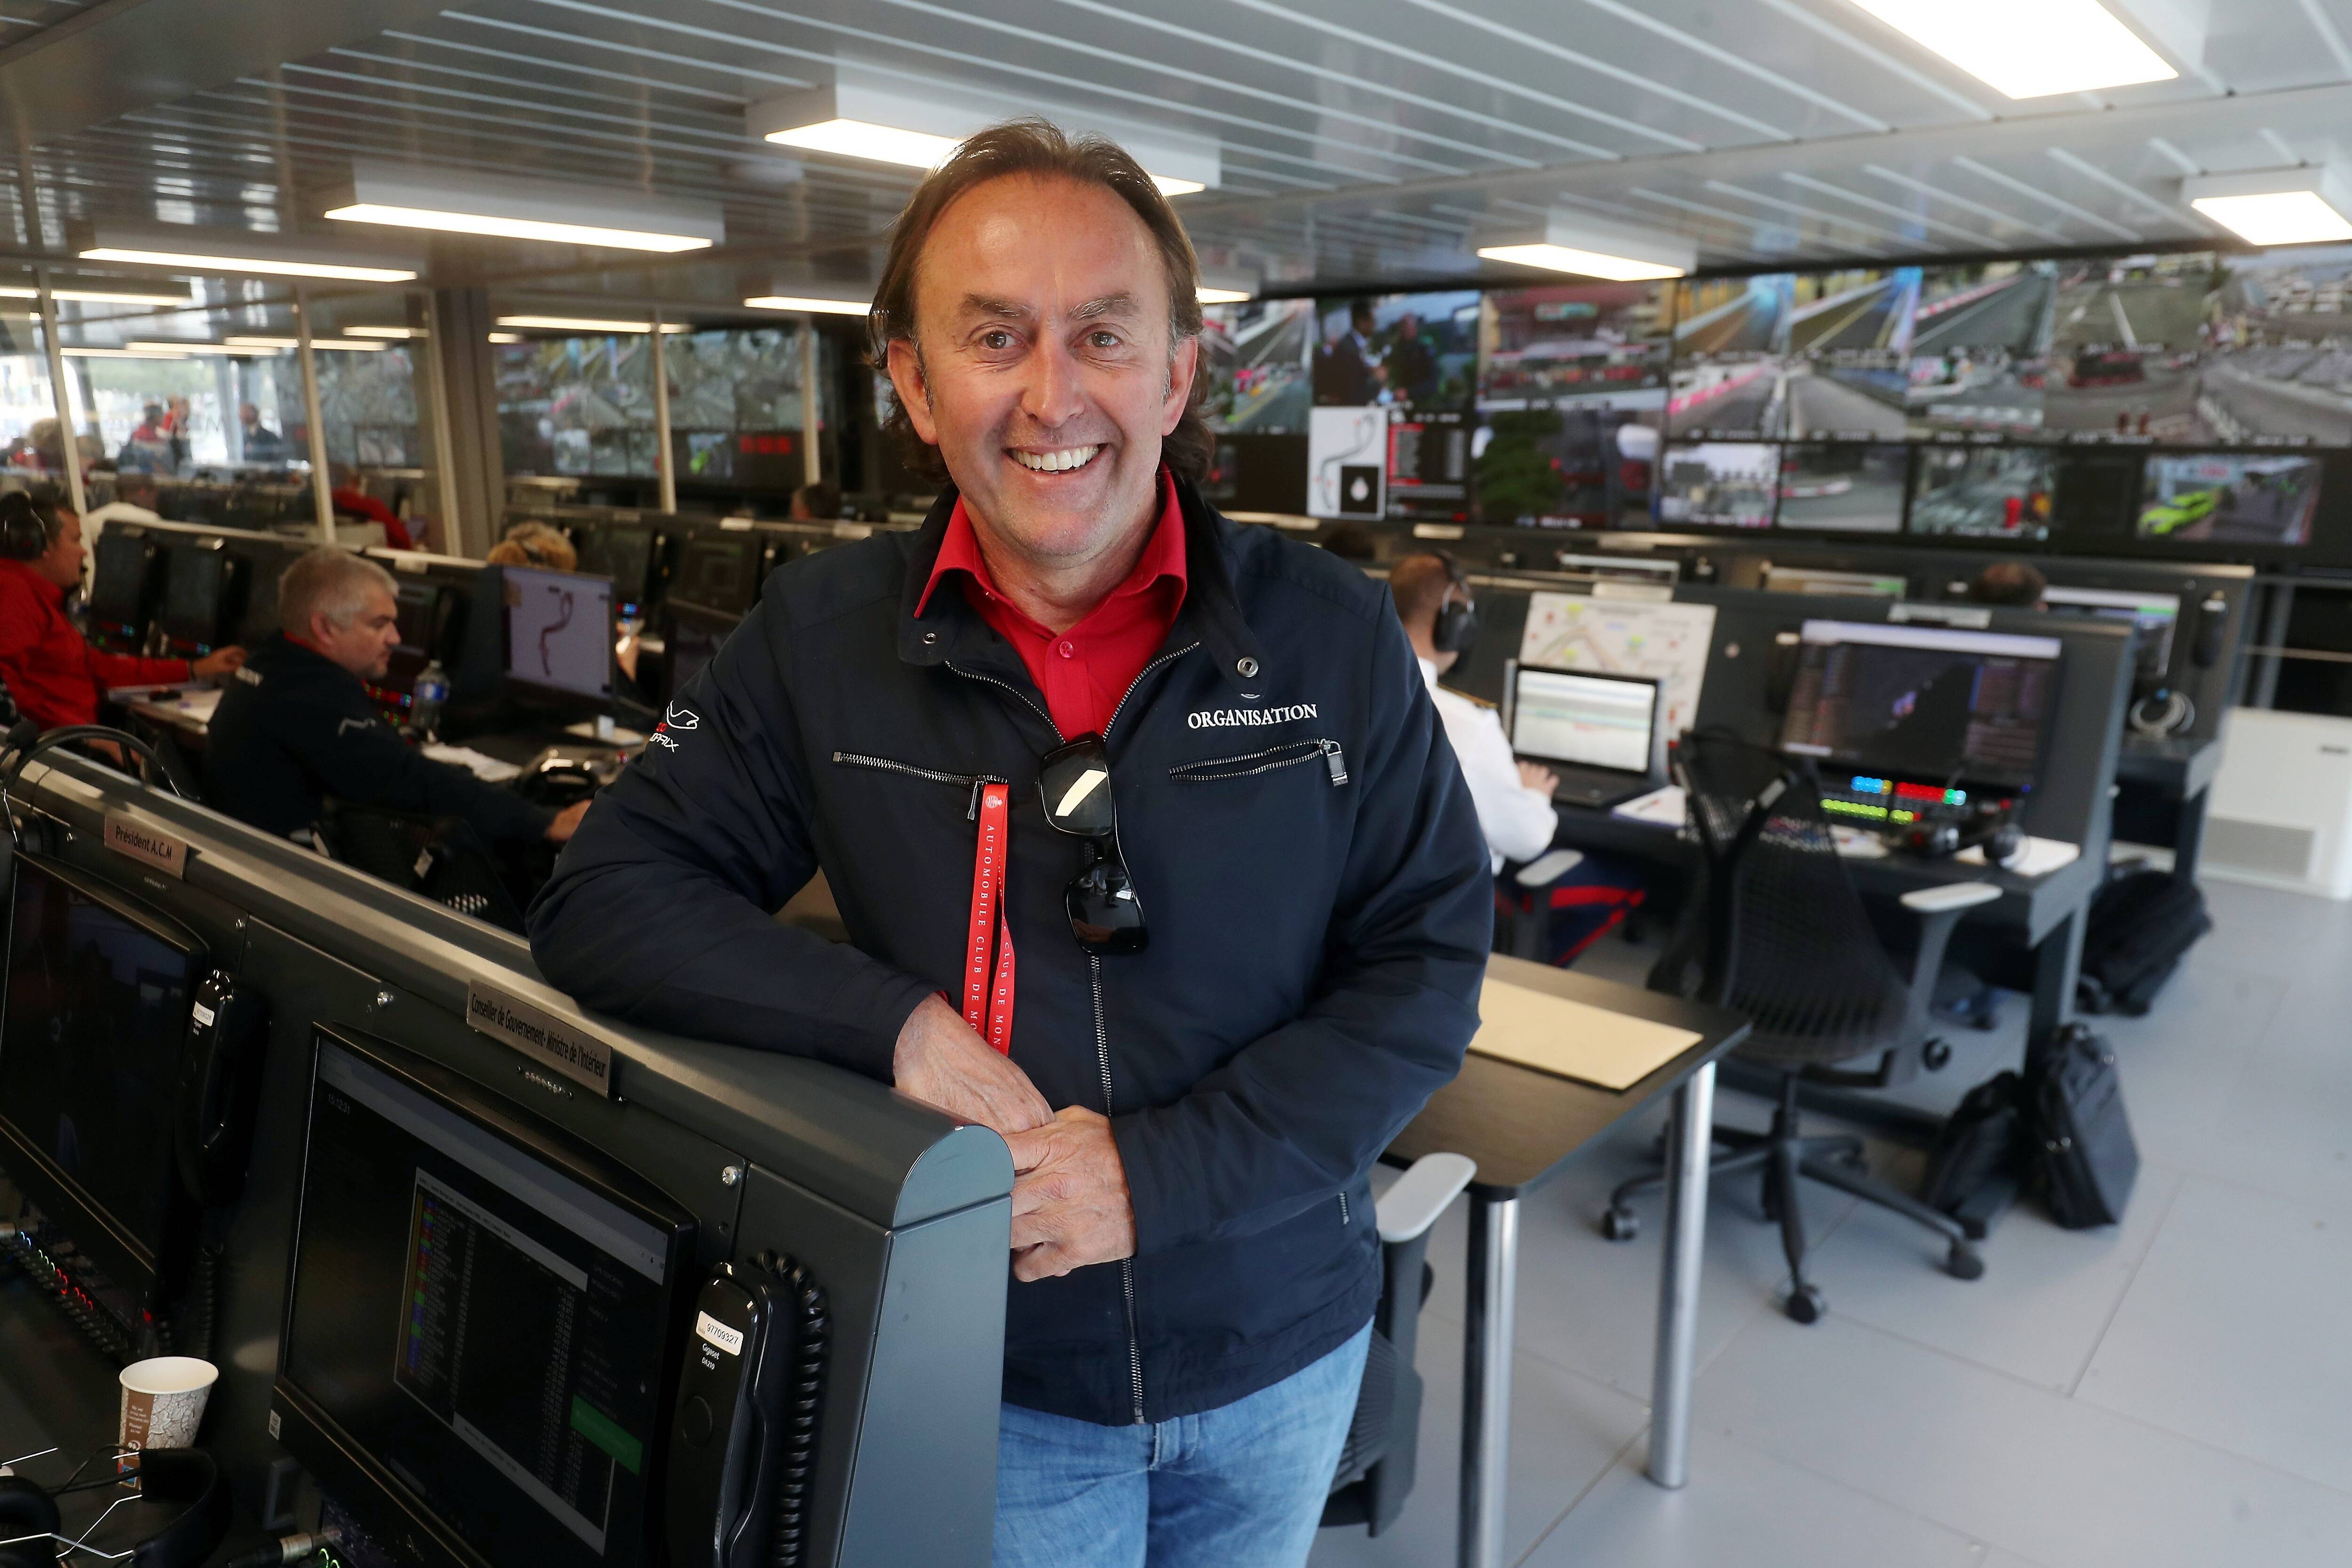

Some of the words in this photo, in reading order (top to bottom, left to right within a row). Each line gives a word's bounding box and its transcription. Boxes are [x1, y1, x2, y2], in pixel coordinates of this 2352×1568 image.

[1188, 704, 1318, 729] ORGANISATION
[116, 825, 150, 852] Président
[978, 824, 995, 926] AUTOMOBILE
[974, 936, 985, 973] CLUB
[1001, 942, 1011, 978] CLUB
[971, 983, 980, 1001] DE
[998, 988, 1007, 1005] DE
[472, 993, 497, 1022] Conseiller
[498, 1006, 505, 1027] de
[546, 1029, 568, 1059] Ministre
[570, 1042, 577, 1063] de
[578, 1046, 606, 1078] l'Intérieur
[707, 1323, 739, 1344] 97709327
[702, 1343, 720, 1360] Gigaset
